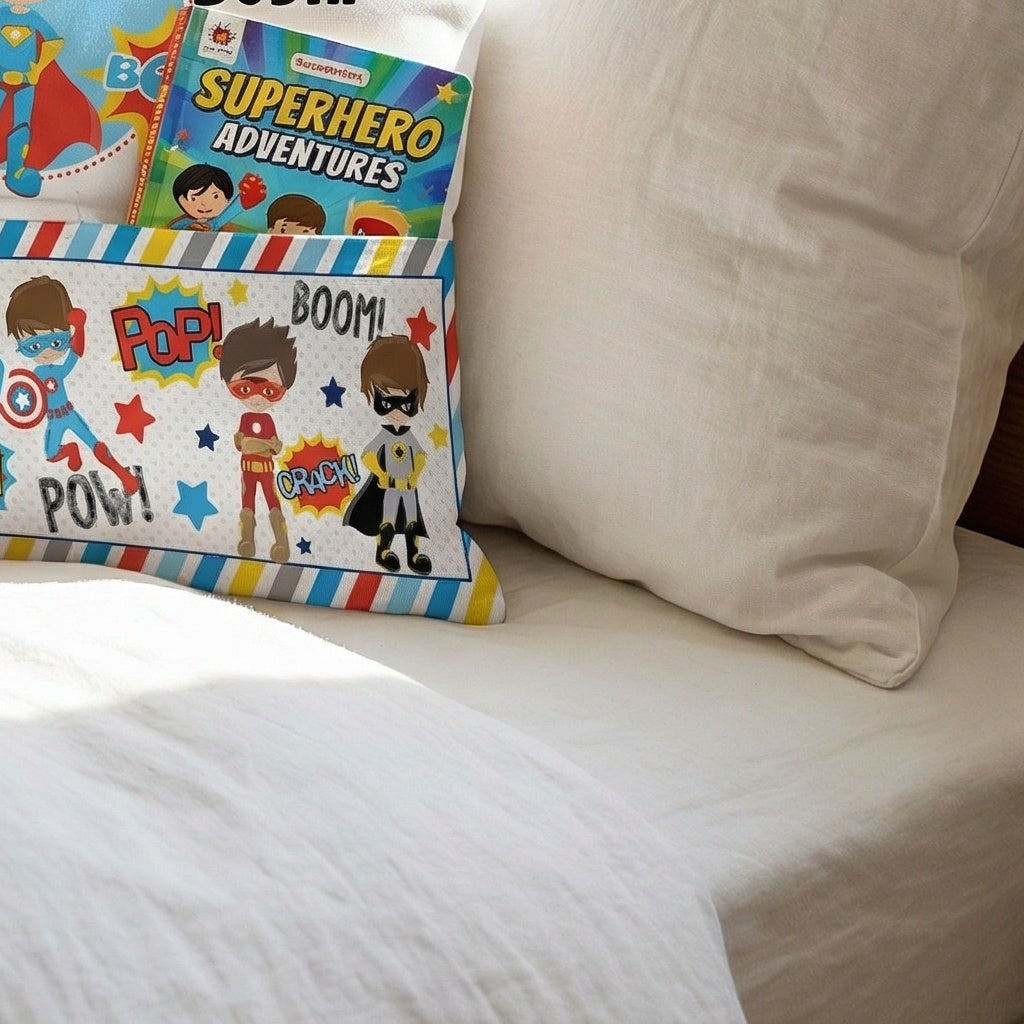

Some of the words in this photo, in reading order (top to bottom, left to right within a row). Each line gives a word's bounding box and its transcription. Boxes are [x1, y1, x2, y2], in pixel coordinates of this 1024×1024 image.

[193, 67, 444, 160] SUPERHERO
[211, 122, 406, 191] ADVENTURES
[39, 465, 155, 533] POW!
[277, 454, 361, 500] CRACK!
